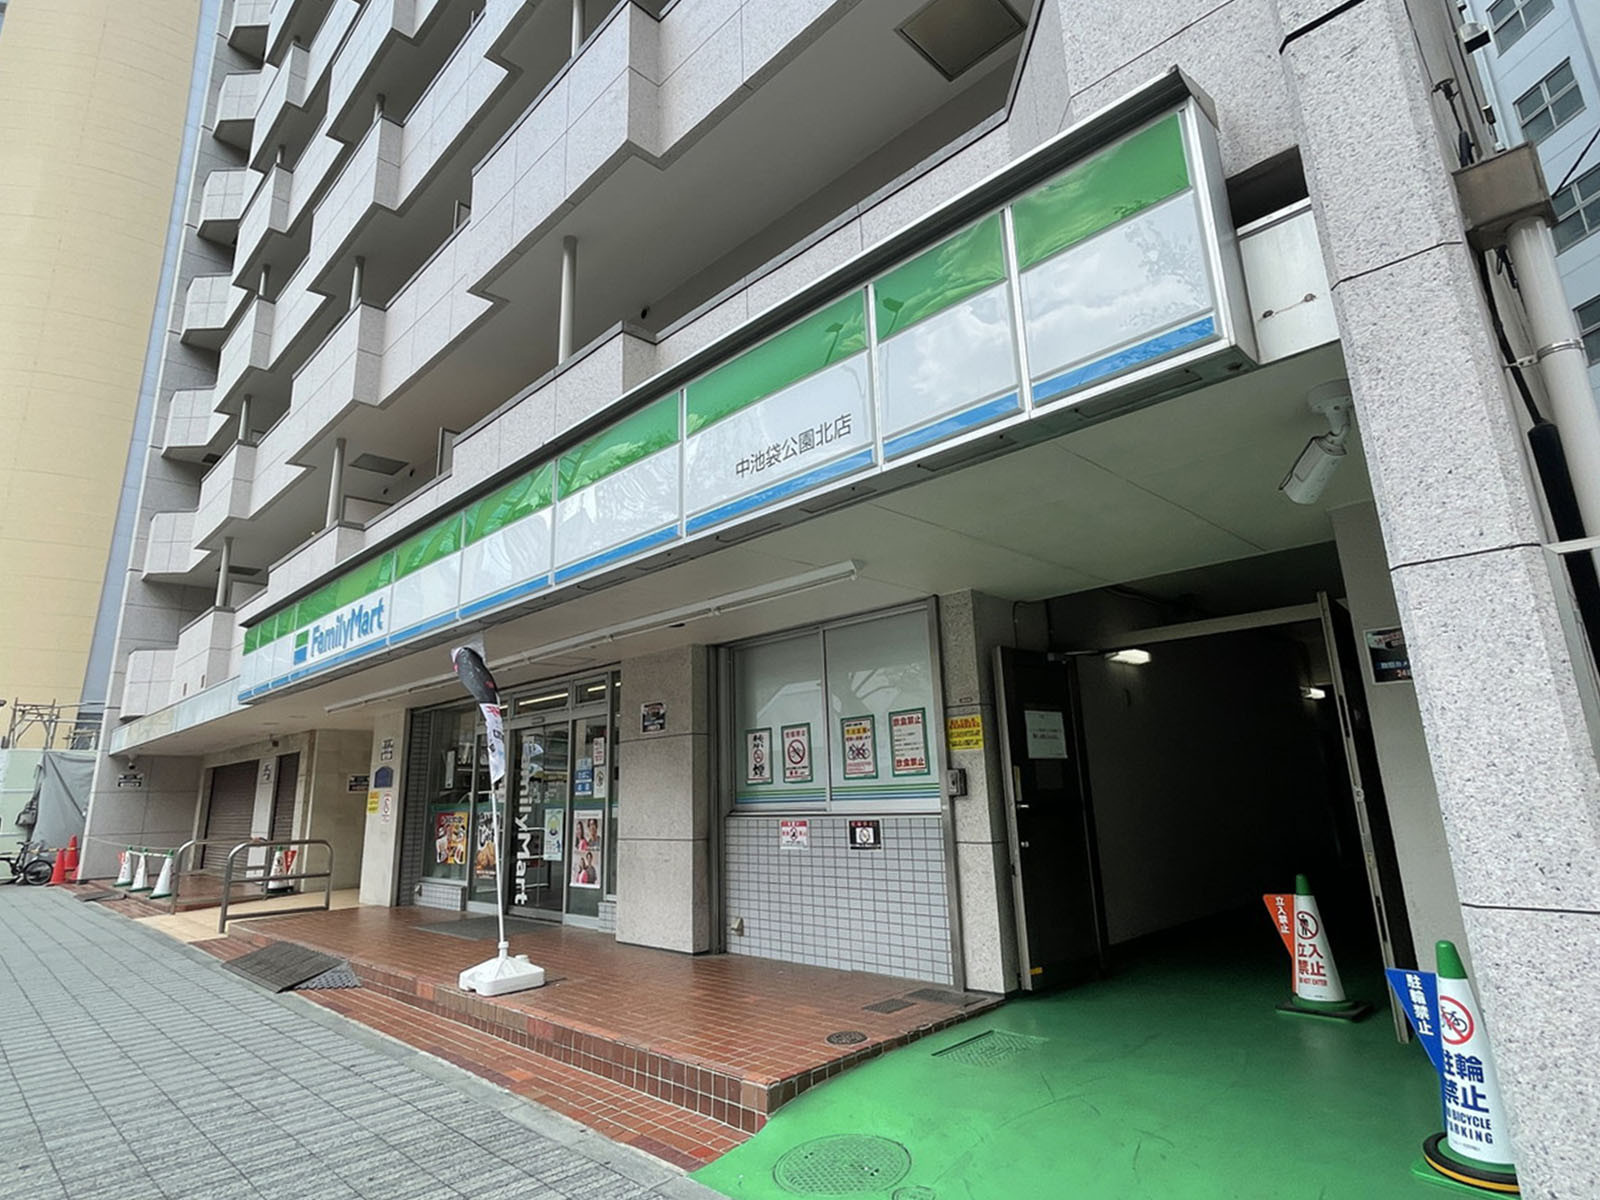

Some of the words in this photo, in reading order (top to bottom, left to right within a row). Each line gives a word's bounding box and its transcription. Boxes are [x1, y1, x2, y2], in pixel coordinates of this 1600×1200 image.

[735, 413, 852, 477] 中池袋公園北店
[311, 597, 384, 656] FamilyMart
[1275, 896, 1291, 934] 立入禁止
[1297, 942, 1324, 959] 立入
[1297, 960, 1327, 978] 禁止
[1405, 973, 1435, 1037] 駐輪禁止
[1447, 1121, 1493, 1144] ARKING
[1452, 1109, 1492, 1130] BICYCLE
